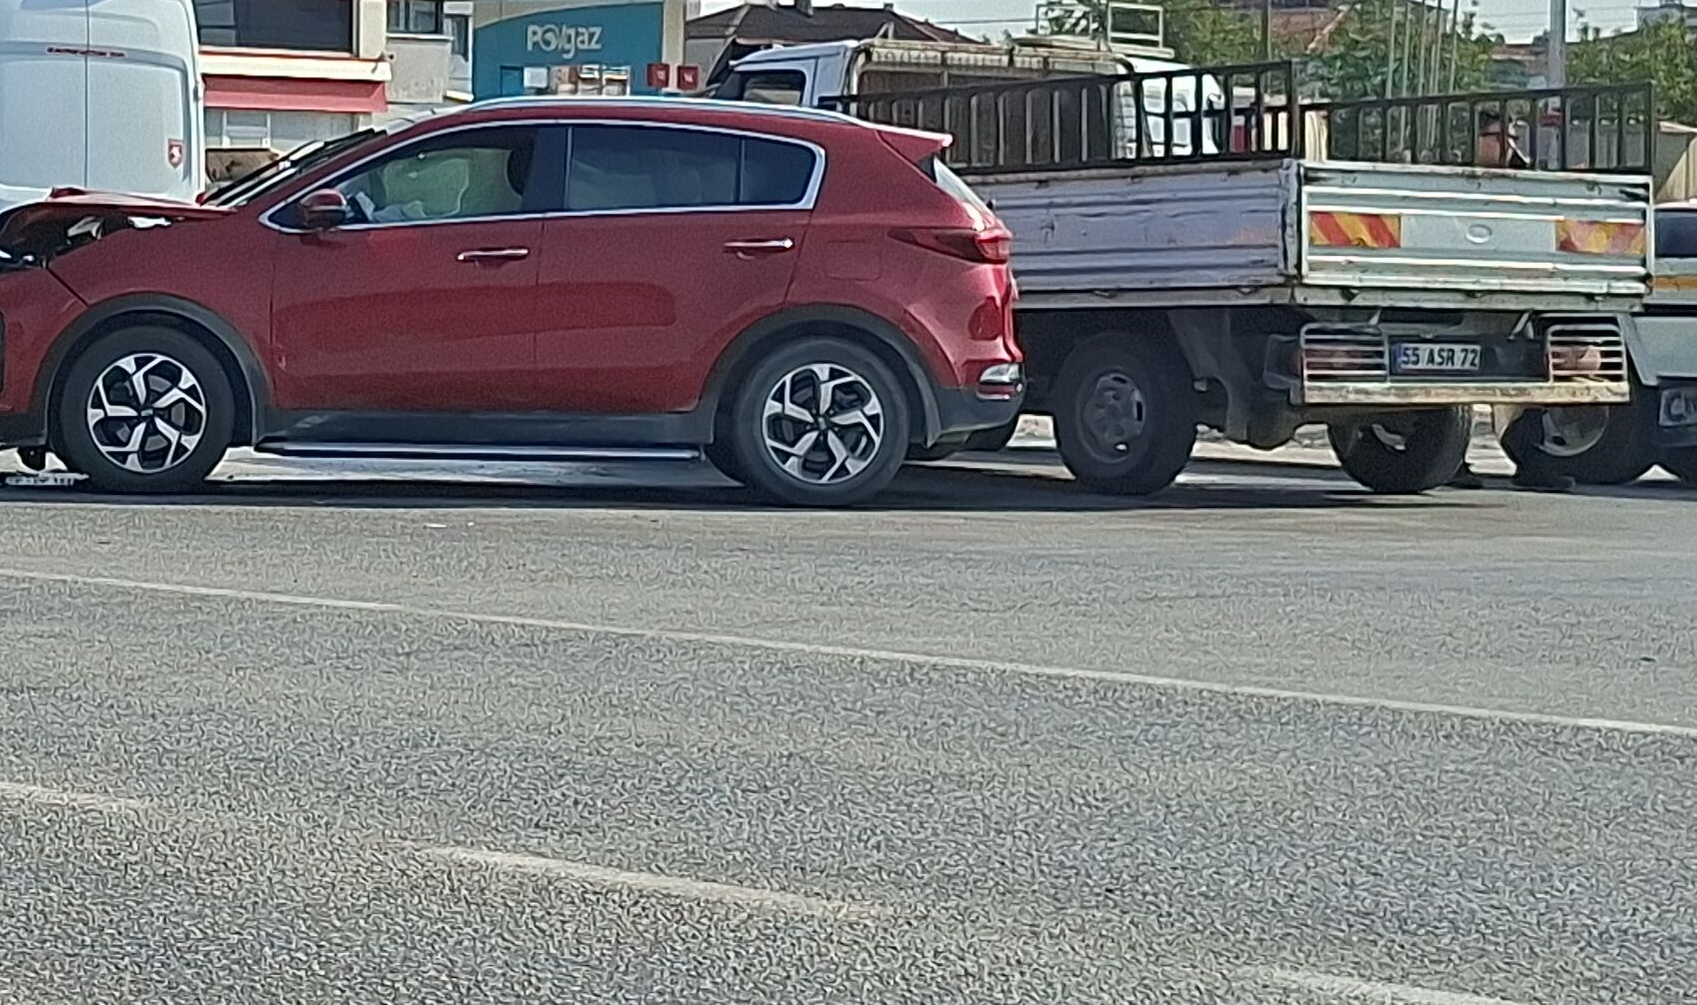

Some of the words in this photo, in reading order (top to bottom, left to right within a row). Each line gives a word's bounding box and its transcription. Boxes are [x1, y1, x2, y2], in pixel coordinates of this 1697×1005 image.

[1401, 347, 1420, 366] 55
[1426, 348, 1455, 367] ASR
[1460, 348, 1478, 368] 72
